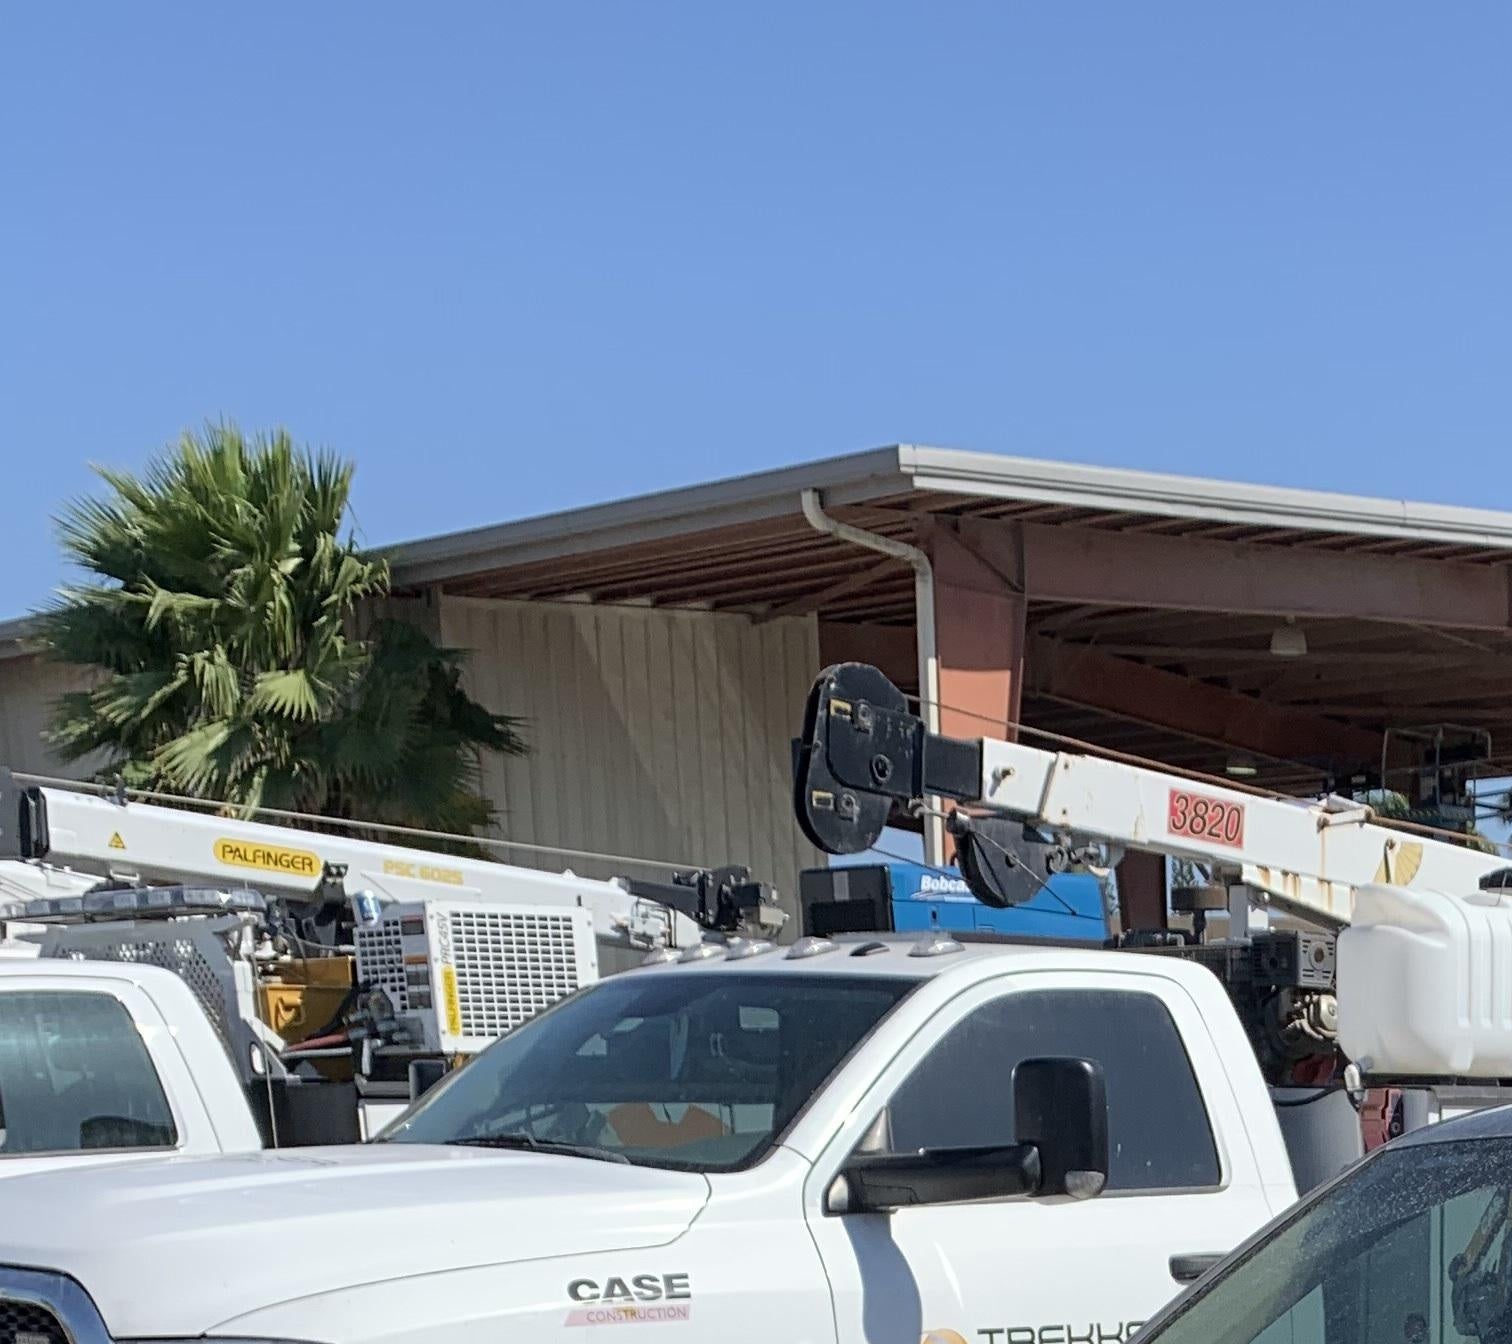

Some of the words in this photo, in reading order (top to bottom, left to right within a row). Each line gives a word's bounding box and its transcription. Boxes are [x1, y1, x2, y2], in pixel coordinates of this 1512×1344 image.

[1172, 794, 1241, 842] 3820
[222, 844, 314, 873] PALFINGER
[921, 874, 971, 893] Bobca
[567, 1272, 692, 1304] CASE
[586, 1306, 688, 1322] CONSTRUCTION
